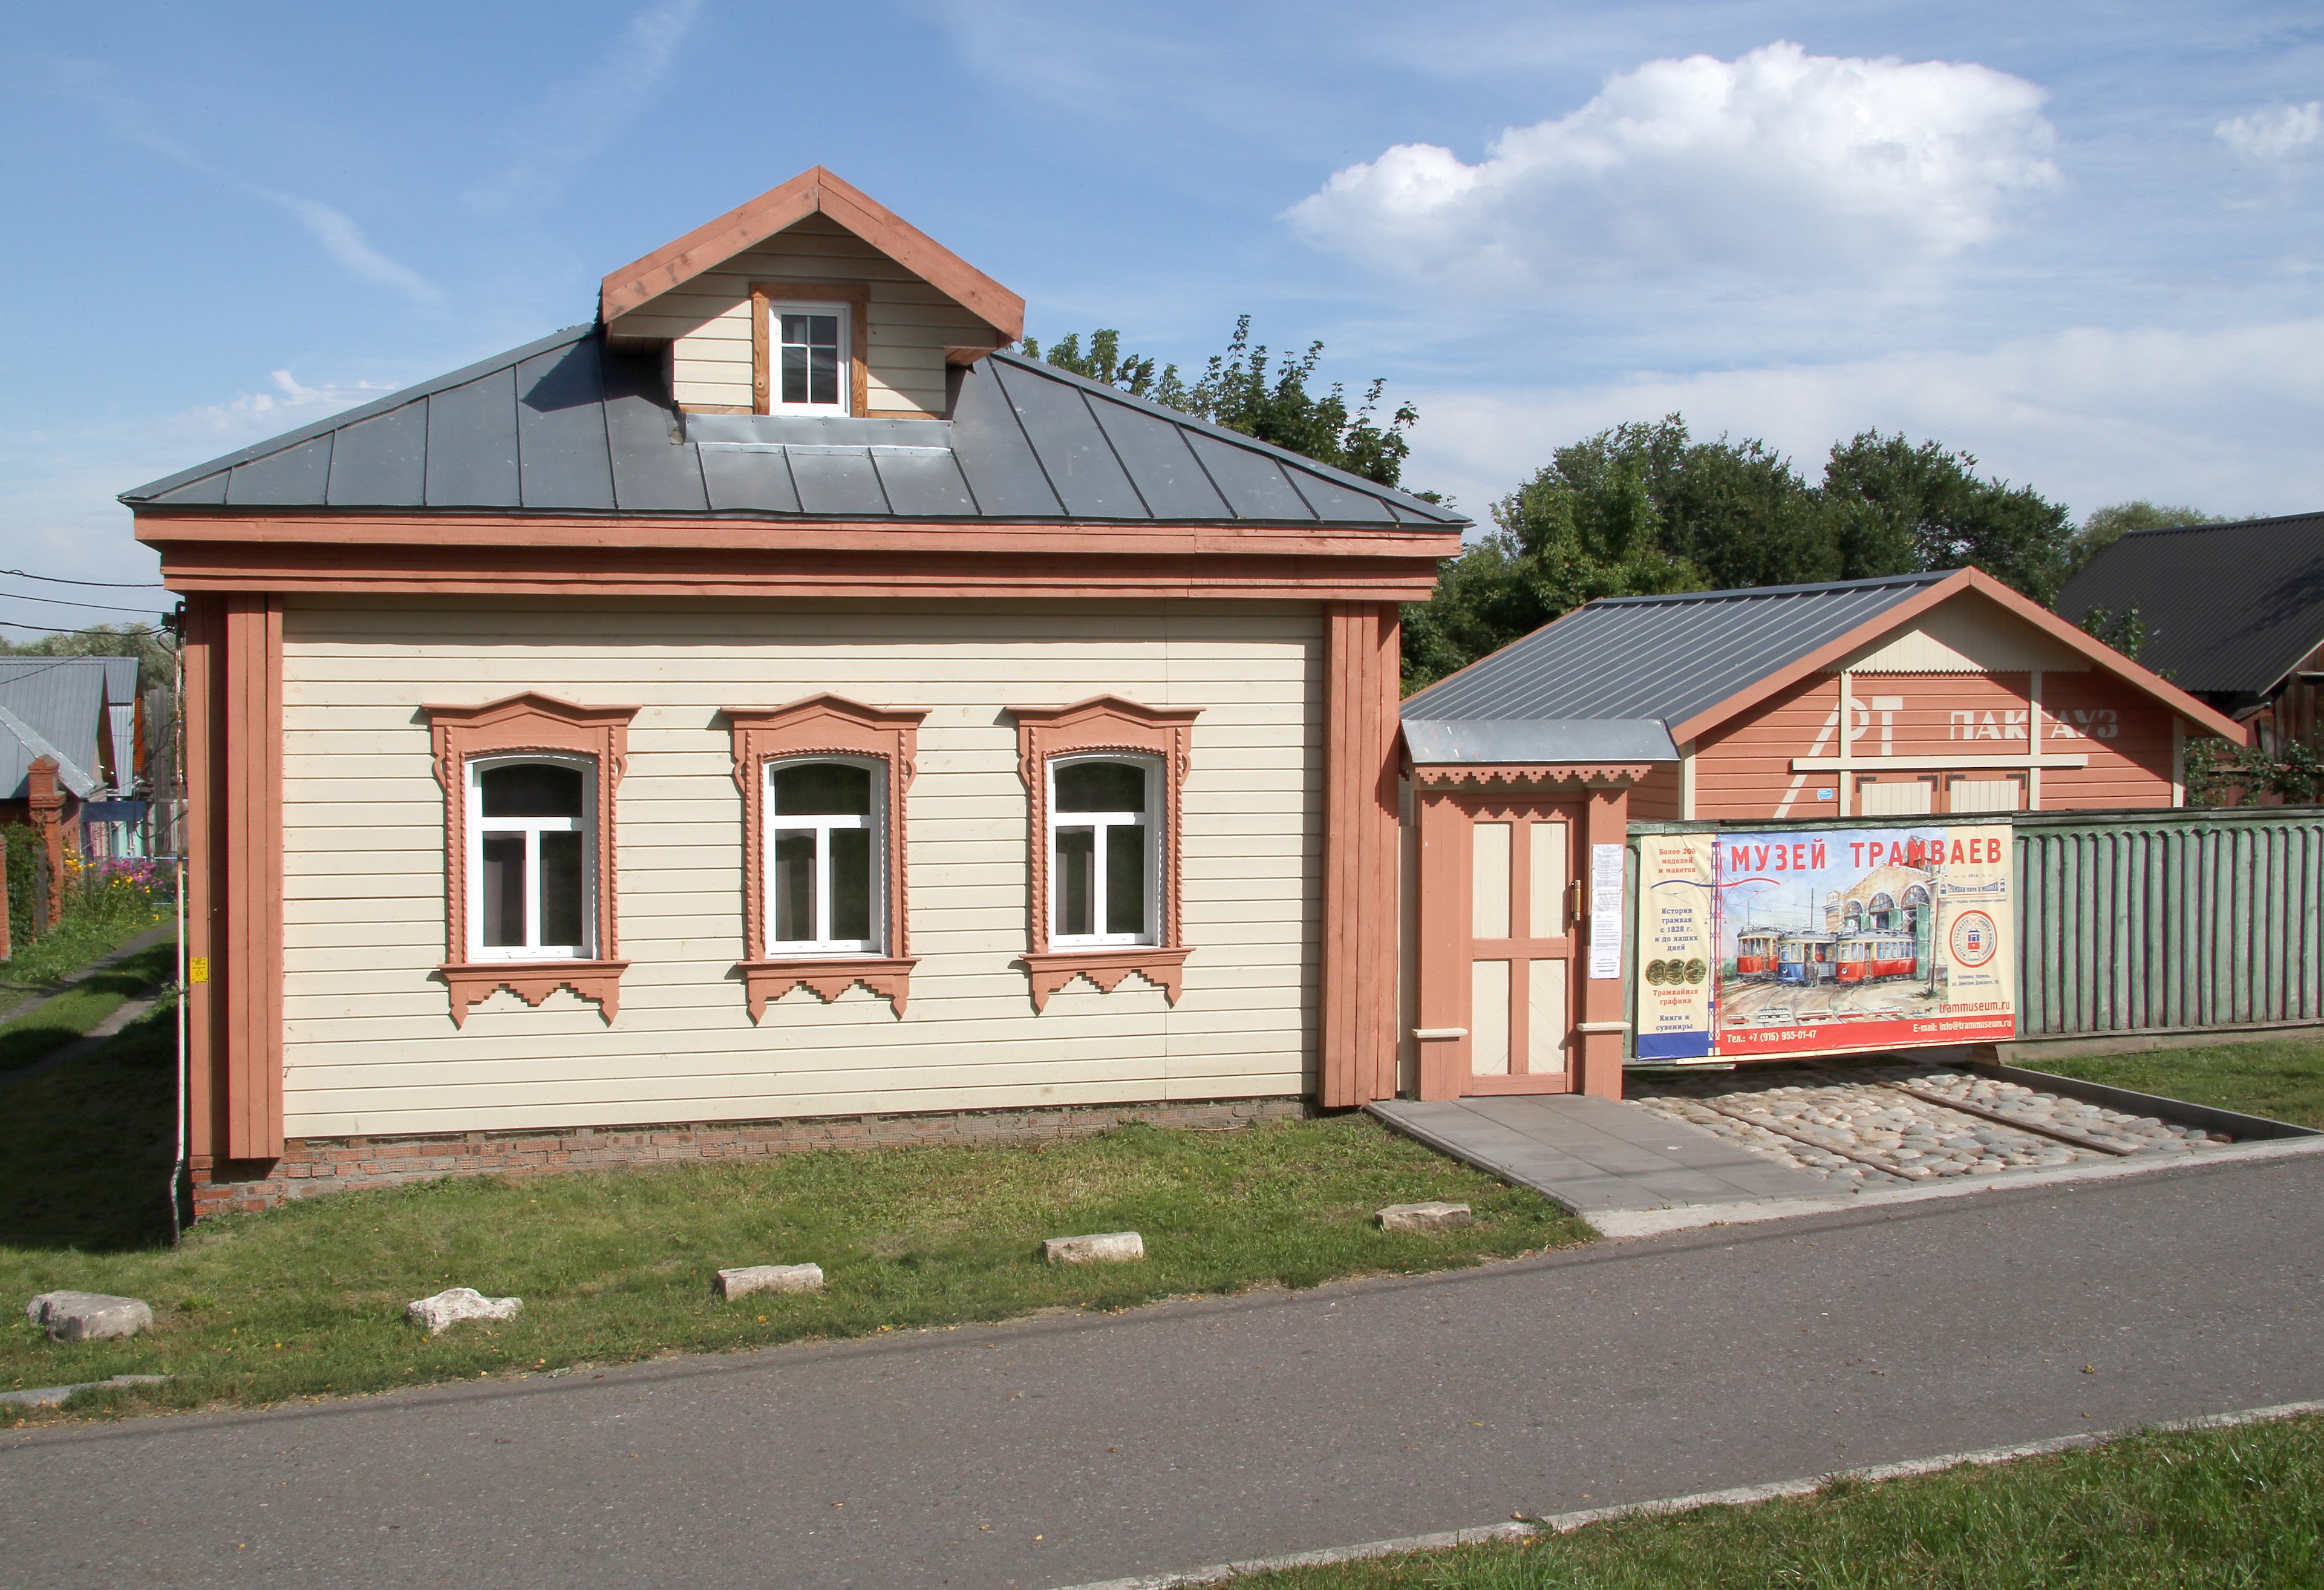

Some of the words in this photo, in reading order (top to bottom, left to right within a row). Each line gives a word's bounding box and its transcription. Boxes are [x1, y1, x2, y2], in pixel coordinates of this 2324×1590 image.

[1731, 839, 1826, 872] МУЗЕЙ
[1849, 837, 2002, 868] ТРАМВАЕВ
[1653, 989, 1699, 997] Трамвайная
[1939, 1001, 2010, 1013] trammuseum.ru
[1913, 1022, 1937, 1033] E-mail:
[1939, 1019, 2012, 1031] info@trammuseum.ru
[1726, 1034, 1746, 1043] Тел.:
[1748, 1033, 1758, 1042] +7
[1760, 1032, 1779, 1042] (916)
[1781, 1030, 1817, 1040] 955-01-47
